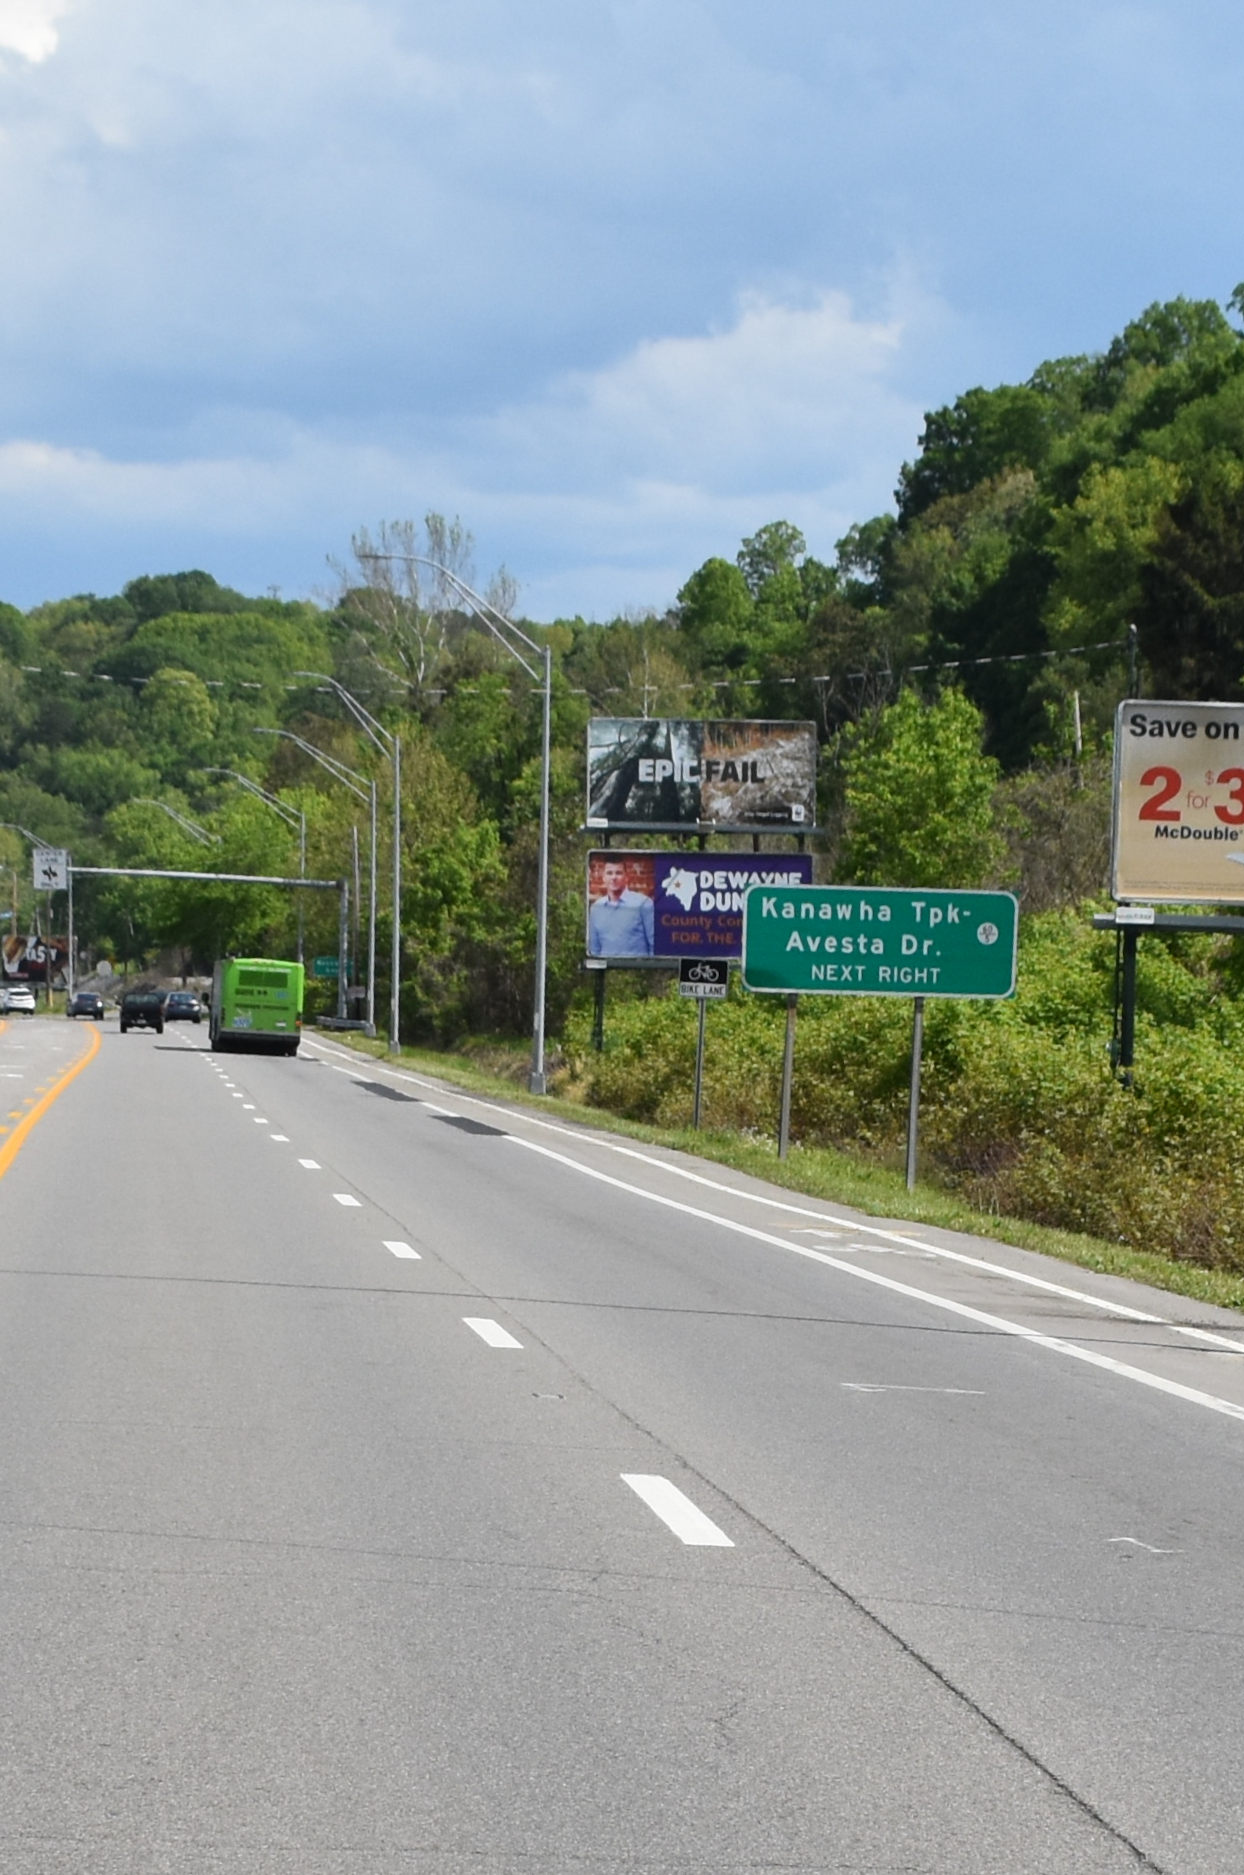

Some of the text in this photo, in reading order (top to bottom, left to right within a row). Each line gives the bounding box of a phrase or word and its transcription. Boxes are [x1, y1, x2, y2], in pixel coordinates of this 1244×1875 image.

[1129, 713, 1198, 739] Save
[1204, 720, 1240, 740] on
[638, 758, 765, 783] EPIC FAIL
[1138, 766, 1182, 822] 2
[1186, 789, 1212, 809] for
[1154, 825, 1241, 841] McDouble
[700, 870, 802, 889] DEWAYNE
[761, 897, 892, 922] Kanawha
[661, 914, 713, 930] County
[785, 930, 942, 957] Avesta Dr.
[810, 964, 941, 984] NEXT RIGHT
[681, 984, 725, 997] BIKE LANE
